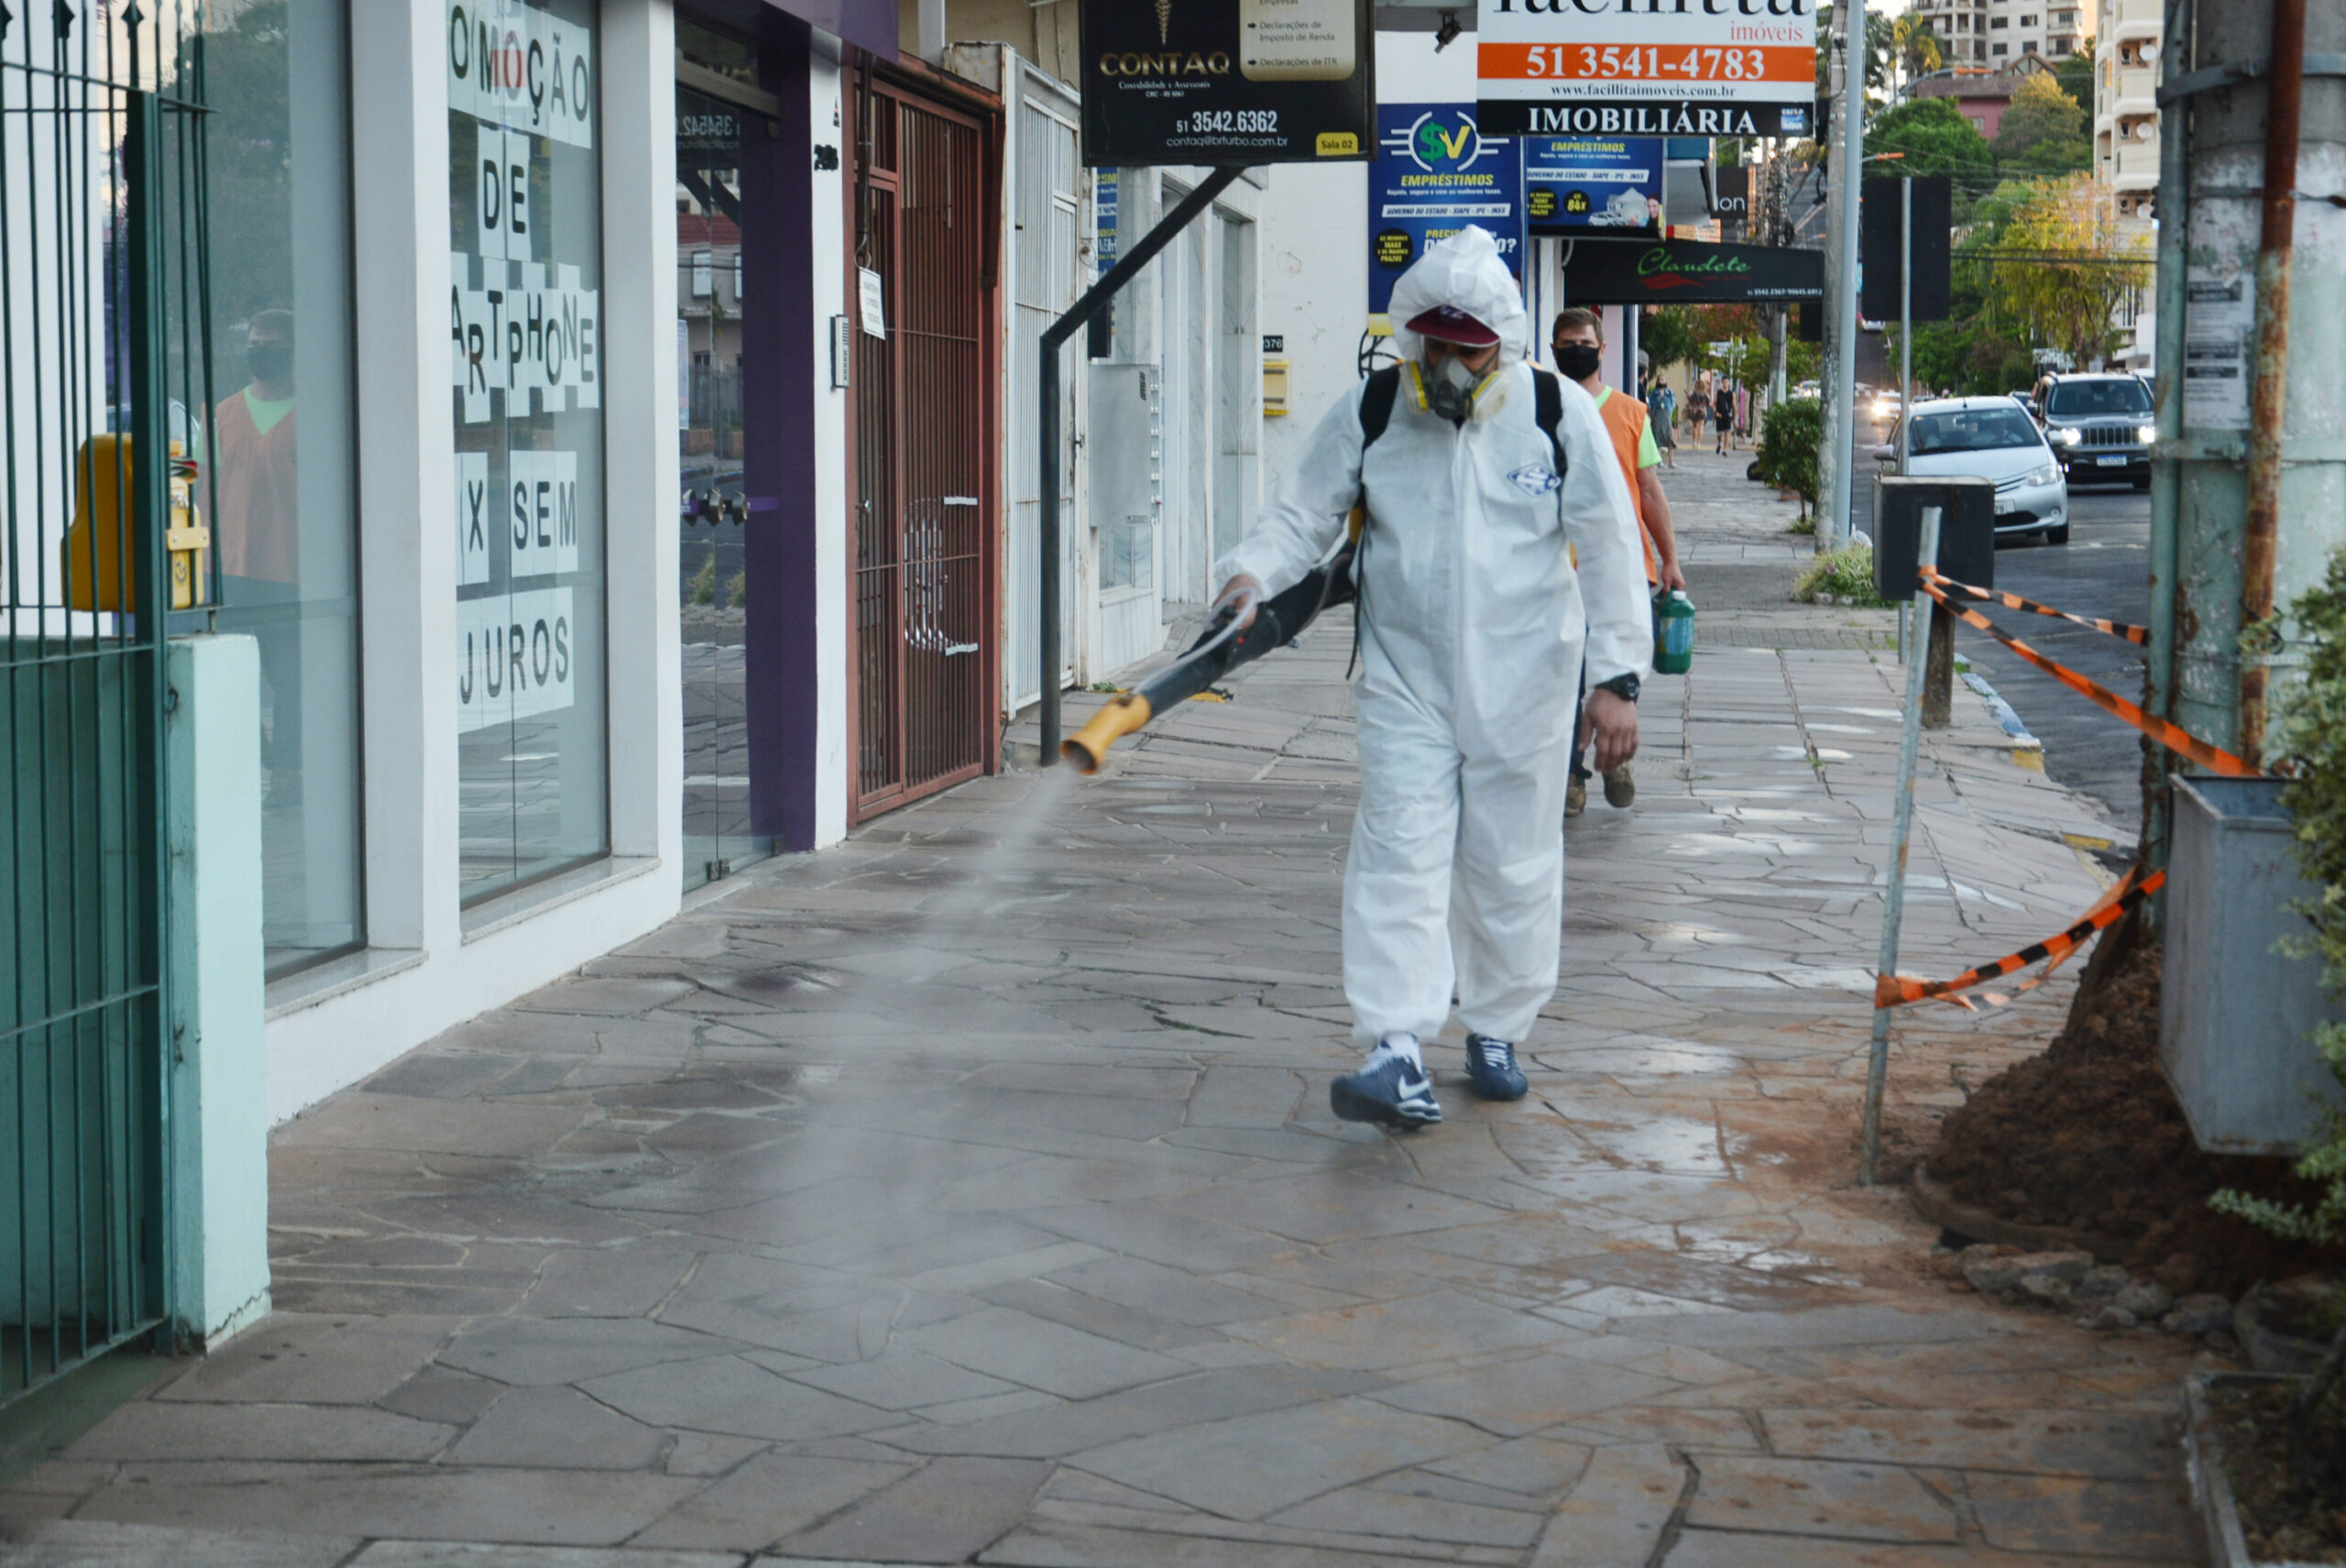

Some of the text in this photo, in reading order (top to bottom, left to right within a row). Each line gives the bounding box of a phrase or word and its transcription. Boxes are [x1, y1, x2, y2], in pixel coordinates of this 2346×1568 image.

[1259, 20, 1321, 31] Declarações de
[1730, 20, 1803, 41] imóveis
[1259, 33, 1335, 42] Imposto de Renda
[1100, 51, 1231, 76] CONTAQ
[1259, 57, 1310, 68] Declarações
[1313, 57, 1323, 66] de
[1527, 47, 1765, 80] 51 3541-4783
[1551, 83, 1737, 98] www.facillitaimoveis.com.br
[1177, 110, 1277, 134] 51 3542.6362
[1529, 102, 1758, 135] IMOBILIÁRIA
[1167, 137, 1288, 148] contaq@brturbo.com.br
[1321, 139, 1354, 149] Sala 02
[1551, 140, 1626, 153] EMPRÉSTIMOS
[1401, 172, 1495, 187] EMPRÉSTIMOS
[483, 159, 526, 234] DE
[452, 285, 595, 394] ARTPHONE
[468, 479, 576, 553] X SEM
[460, 616, 569, 705] JUROS
